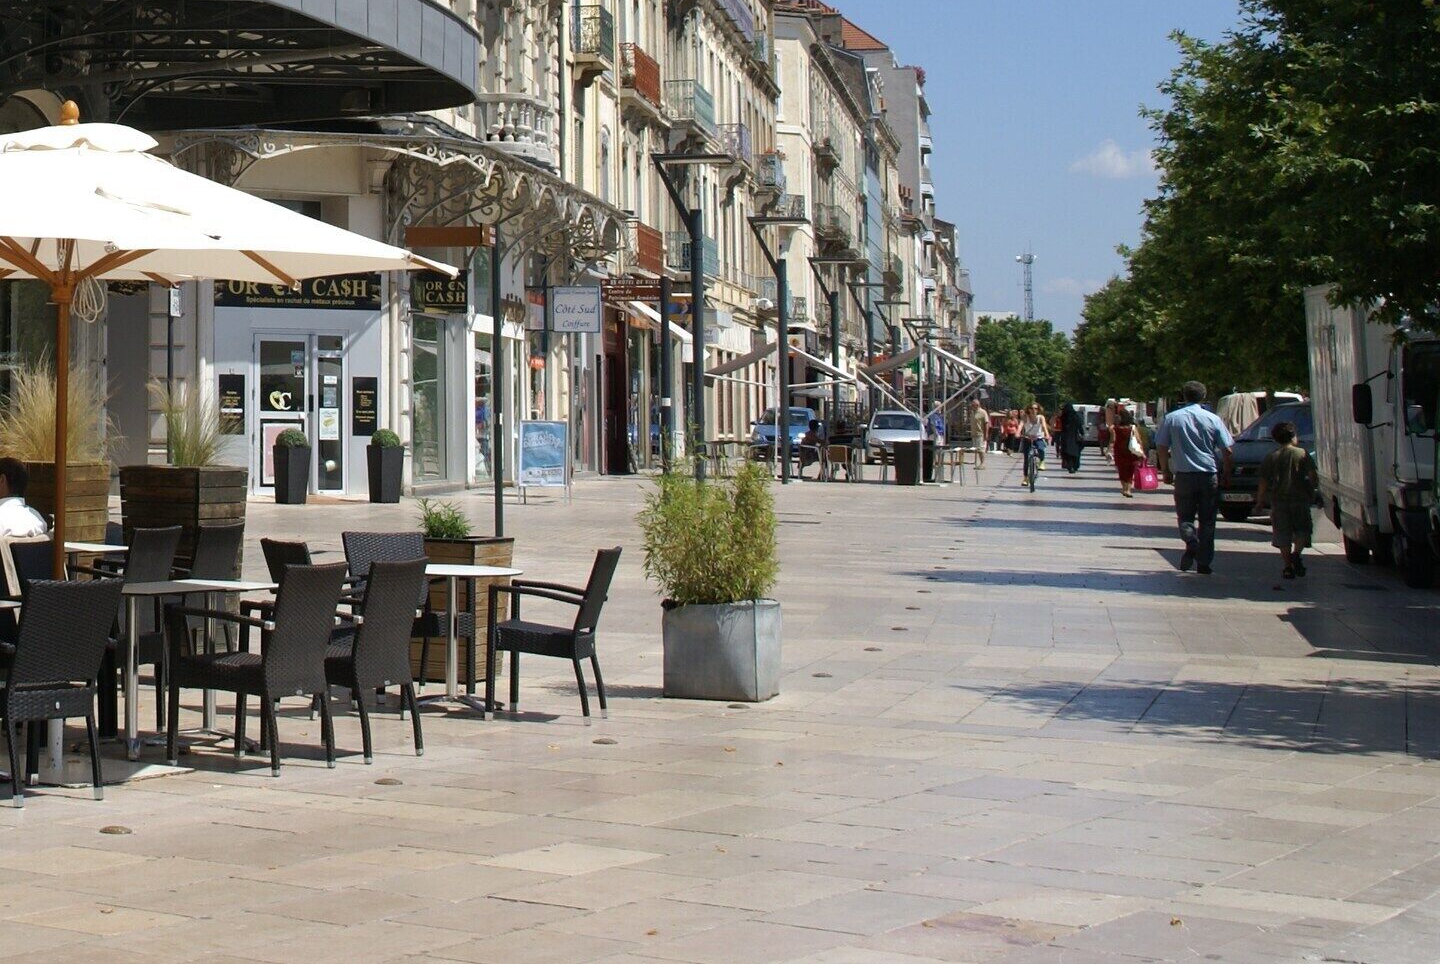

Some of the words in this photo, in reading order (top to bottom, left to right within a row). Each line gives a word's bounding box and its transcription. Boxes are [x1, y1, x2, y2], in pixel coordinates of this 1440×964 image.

[425, 281, 442, 291] OR
[578, 304, 597, 314] Sud
[562, 319, 590, 328] Coiffure
